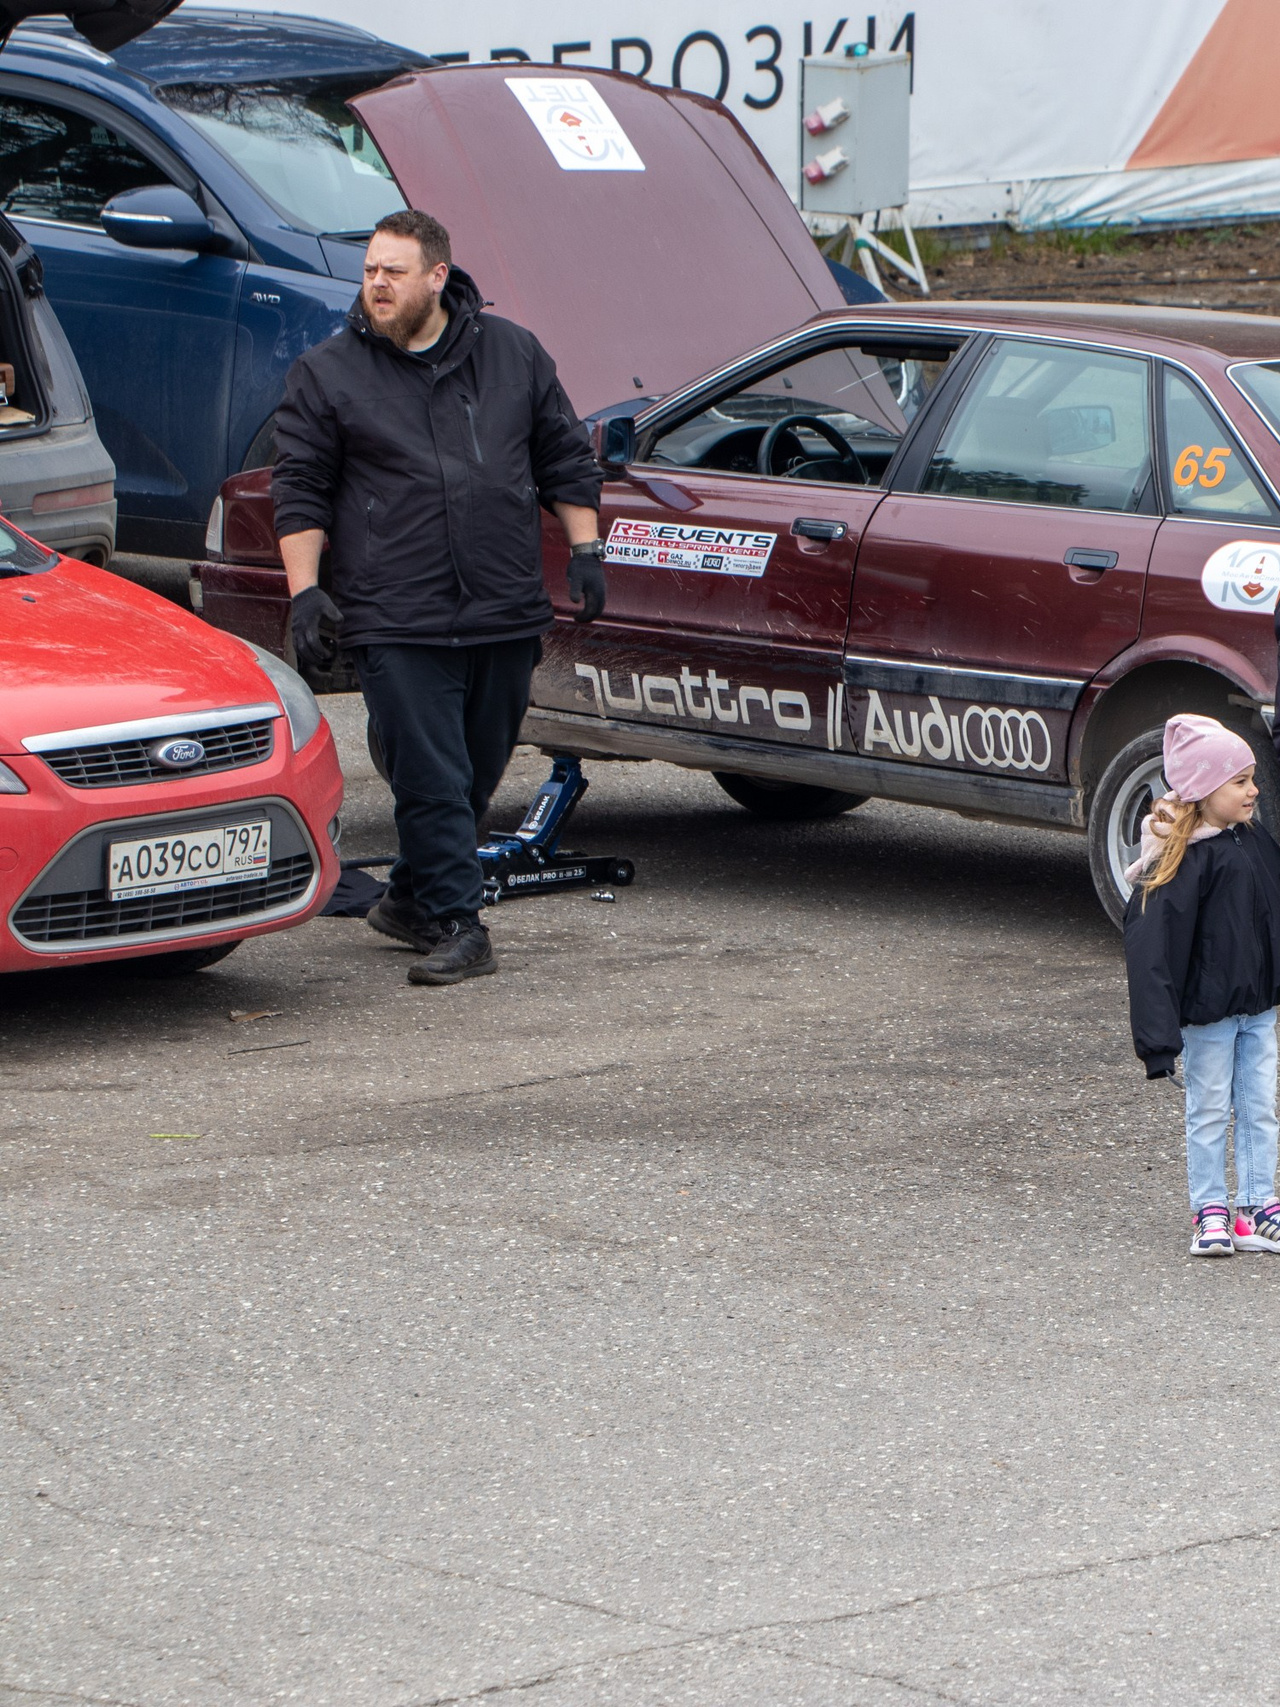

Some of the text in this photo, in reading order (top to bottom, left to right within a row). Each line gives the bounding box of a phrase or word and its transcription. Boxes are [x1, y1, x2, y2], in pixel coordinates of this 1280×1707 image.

[251, 292, 281, 304] AWD
[1173, 445, 1232, 488] 65
[657, 526, 774, 549] EVENTS
[864, 690, 966, 762] Audi
[172, 745, 196, 761] Ford
[226, 825, 263, 857] 797
[234, 855, 253, 867] RUS
[516, 873, 540, 884] БЕЛАК
[542, 872, 557, 880] PRO
